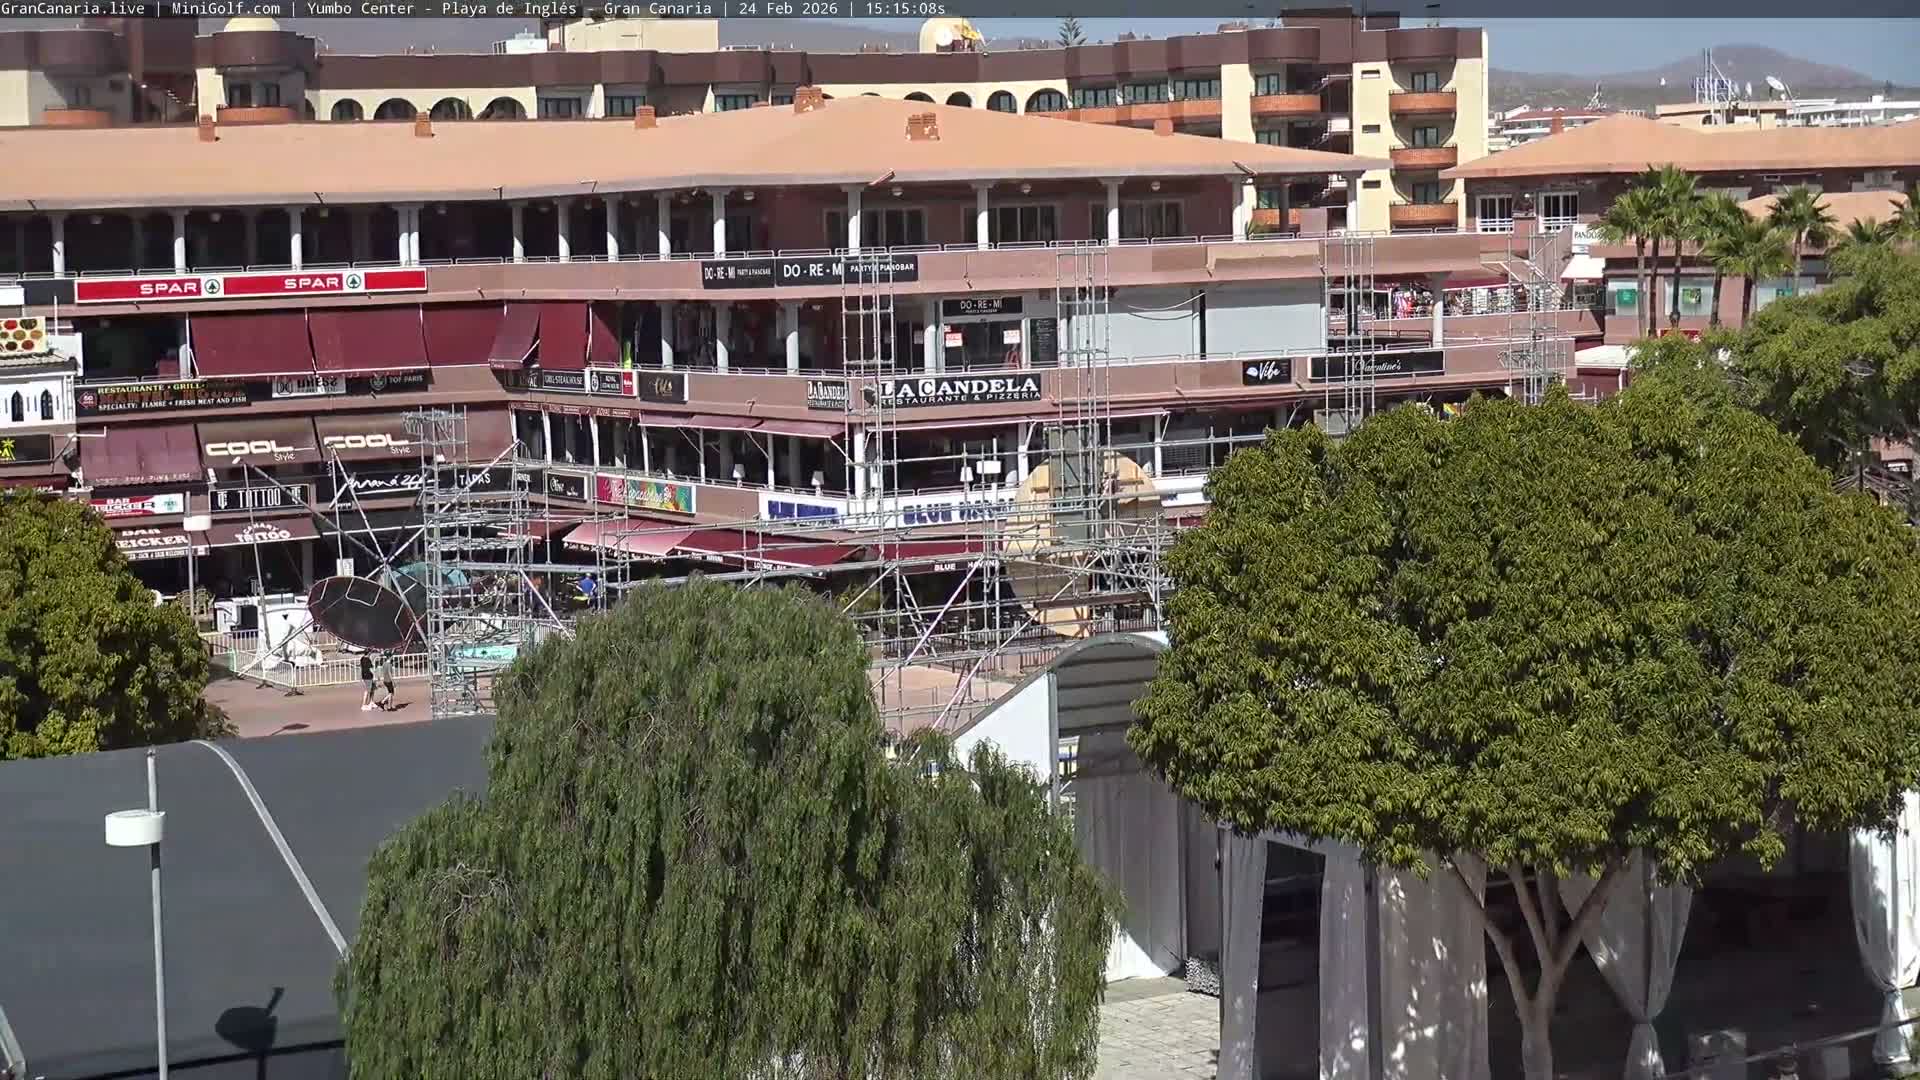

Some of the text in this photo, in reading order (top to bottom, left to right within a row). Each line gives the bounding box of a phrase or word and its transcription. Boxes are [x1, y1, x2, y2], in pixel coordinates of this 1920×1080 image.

[783, 264, 800, 277] DO
[809, 263, 824, 276] RE
[140, 282, 198, 295] SPAR
[284, 277, 339, 290] SPAR
[97, 382, 202, 395] RESTAURANTE GRILL
[880, 377, 1039, 399] LA CANDELA
[881, 394, 967, 406] RESTAURANTE
[986, 392, 1041, 400] PIZZERIA
[98, 402, 138, 412] SPECIALTY:
[206, 440, 294, 456] COOL
[324, 434, 410, 449] COOL
[275, 452, 296, 462] Style
[390, 446, 411, 455] Style
[459, 472, 491, 486] TAPAS
[106, 497, 130, 505] BAR
[238, 488, 281, 509] TATTOO
[235, 529, 291, 542] TATTOO
[934, 563, 956, 571] BLUE
